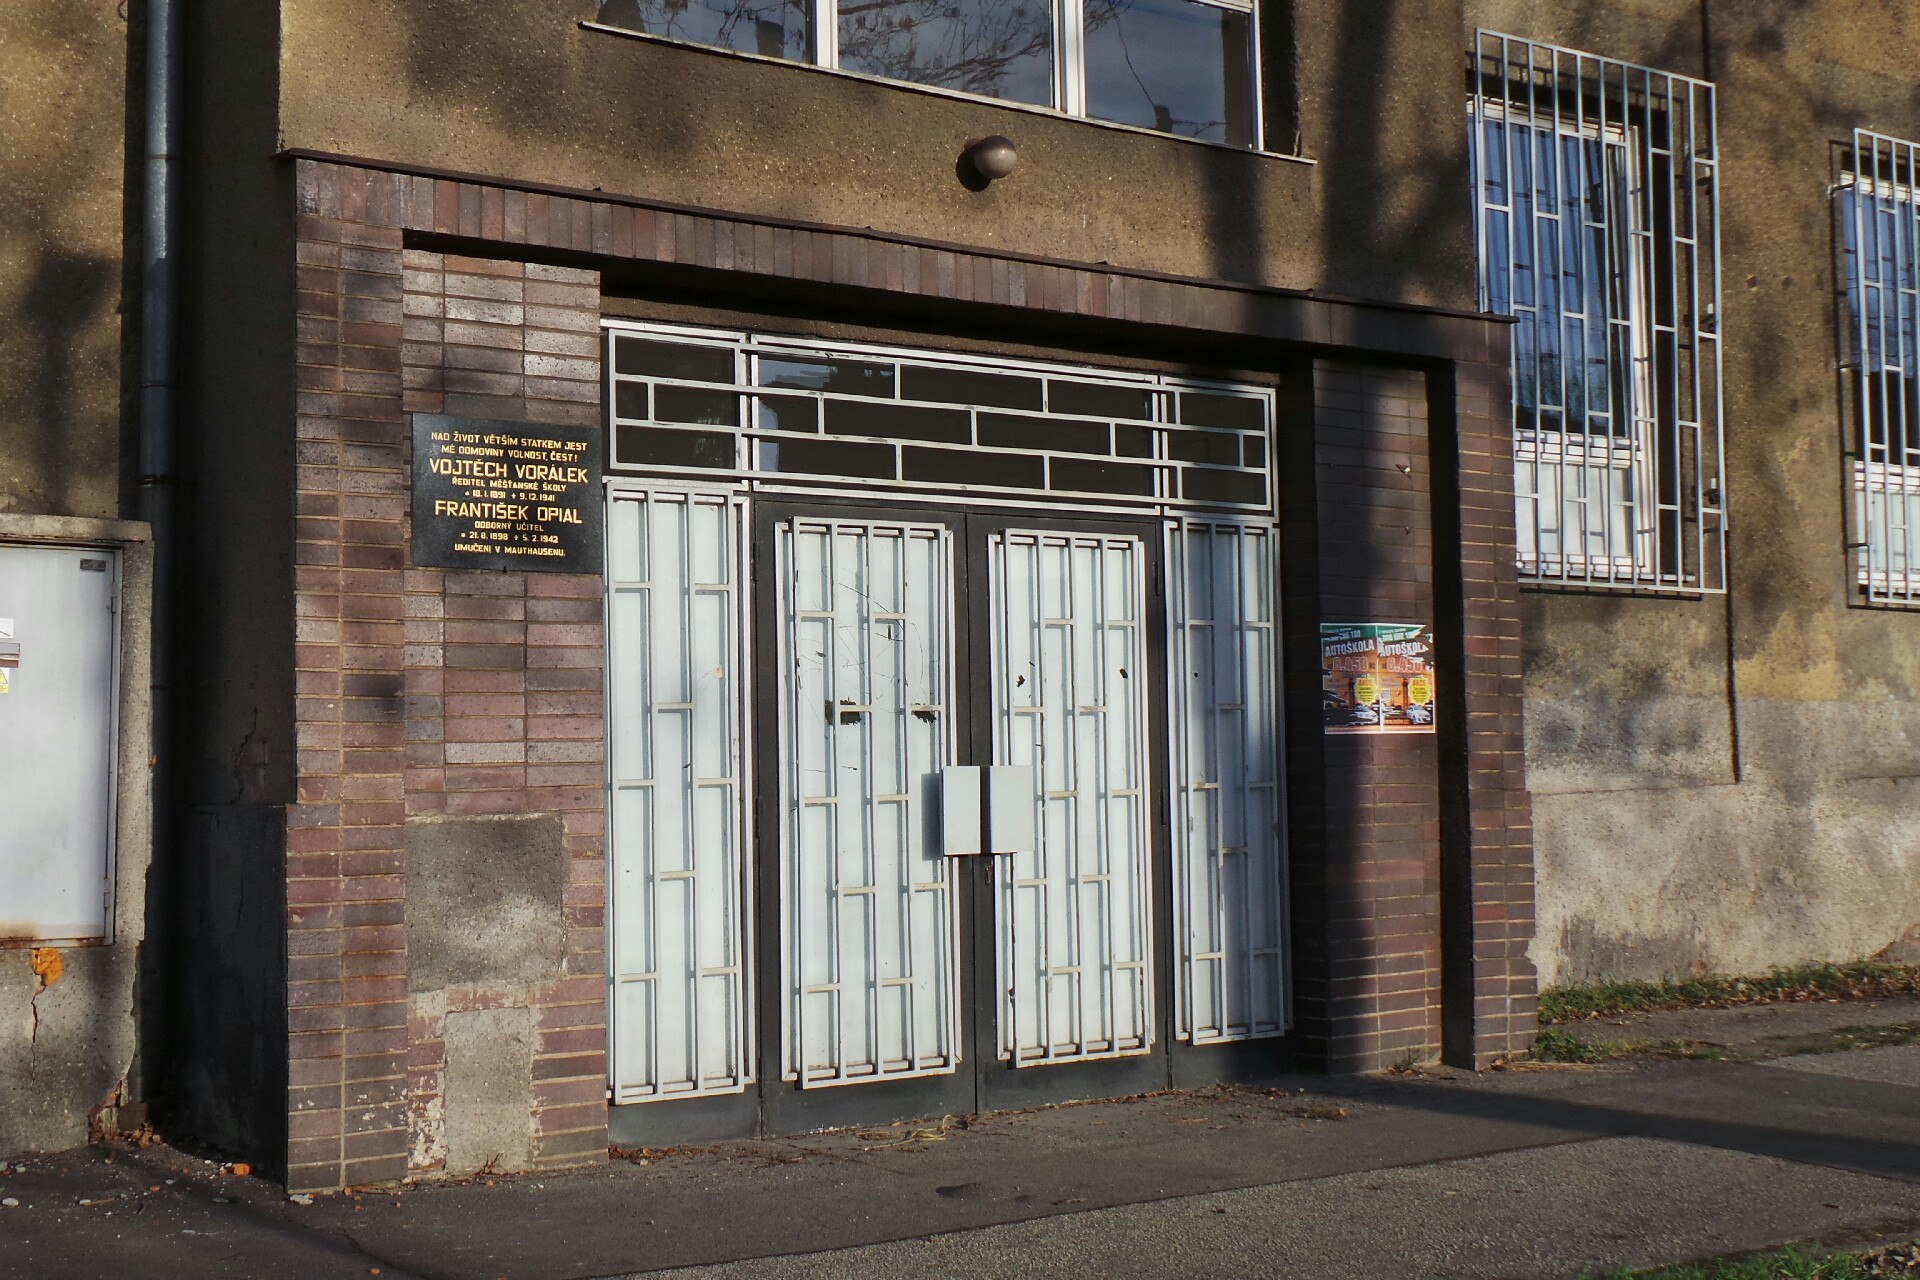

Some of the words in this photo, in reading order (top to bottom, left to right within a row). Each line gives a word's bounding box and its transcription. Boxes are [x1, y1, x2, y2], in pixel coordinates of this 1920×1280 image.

[431, 432, 450, 441] NAD
[453, 431, 480, 443] ŽIVOT
[483, 433, 518, 446] VĚTŠÍM
[521, 438, 562, 449] STATKEM
[564, 441, 587, 451] JEST
[441, 444, 455, 454] MÉ
[458, 446, 504, 457] DOMOVINY
[508, 449, 548, 461] VOLNOST,
[429, 458, 507, 478] VOJTĚCH
[515, 463, 588, 483] VORÁLEK
[452, 476, 486, 487] ŘEDITEL
[489, 479, 538, 491] MĚŠŤANSKÉ
[542, 482, 566, 492] ŠKOLY
[434, 500, 529, 520] FRANTIŠEK
[537, 506, 583, 524] OPIAL
[474, 520, 512, 530] ODBORNÝ
[516, 522, 544, 532] UČITEL
[454, 543, 492, 554] UMUČENI
[494, 545, 501, 554] V
[1325, 639, 1375, 657] AUTOŠKOLA
